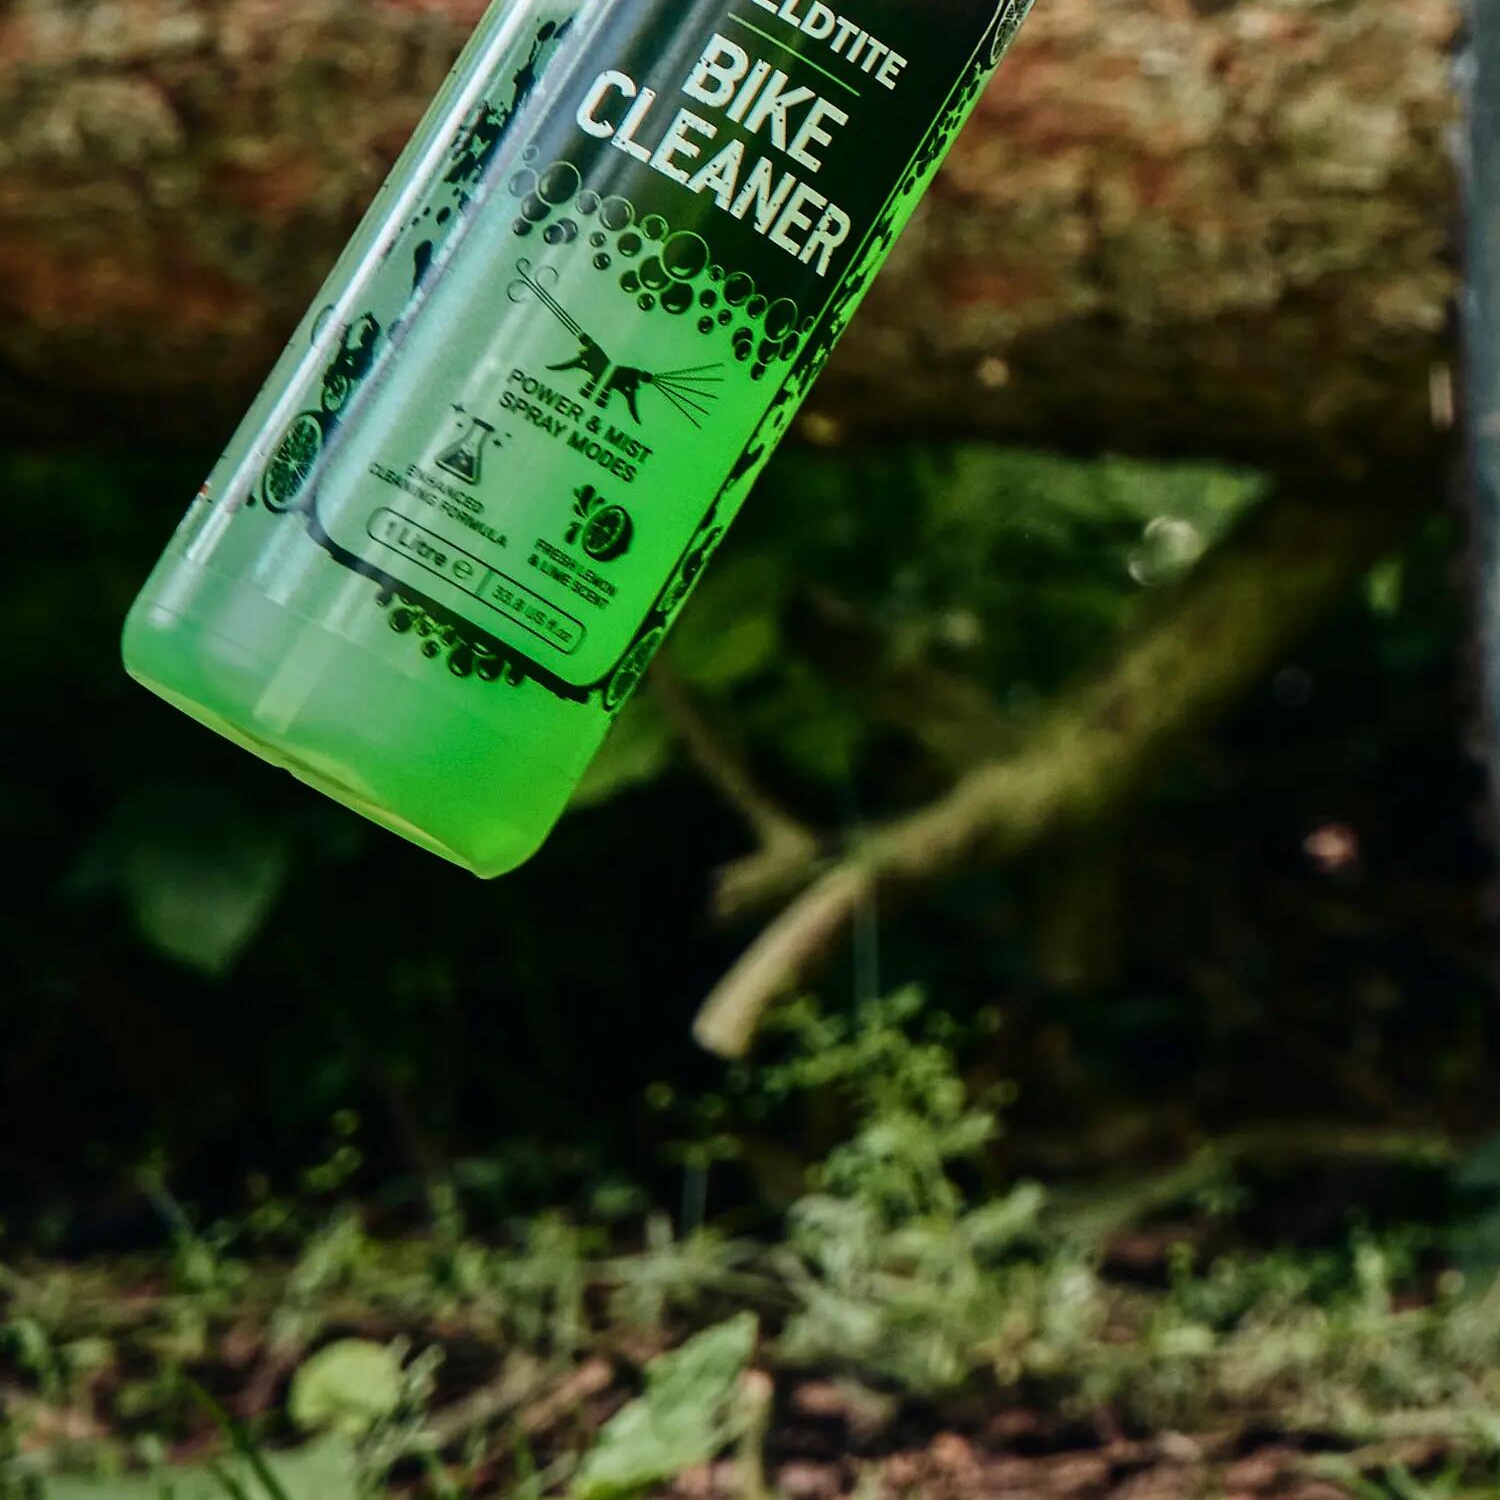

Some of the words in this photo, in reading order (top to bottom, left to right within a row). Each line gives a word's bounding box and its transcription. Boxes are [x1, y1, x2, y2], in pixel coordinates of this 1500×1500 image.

[681, 32, 849, 173] BIKE
[575, 69, 851, 277] CLEANER
[499, 391, 567, 438] SPRAY
[566, 430, 637, 484] MODES
[507, 368, 584, 422] POWER
[585, 415, 602, 435] &
[604, 425, 654, 465] MIST
[368, 462, 438, 508] CLEANING
[440, 500, 507, 548] FORMULA
[406, 464, 485, 514] ENHANCED
[398, 527, 448, 567] Litre
